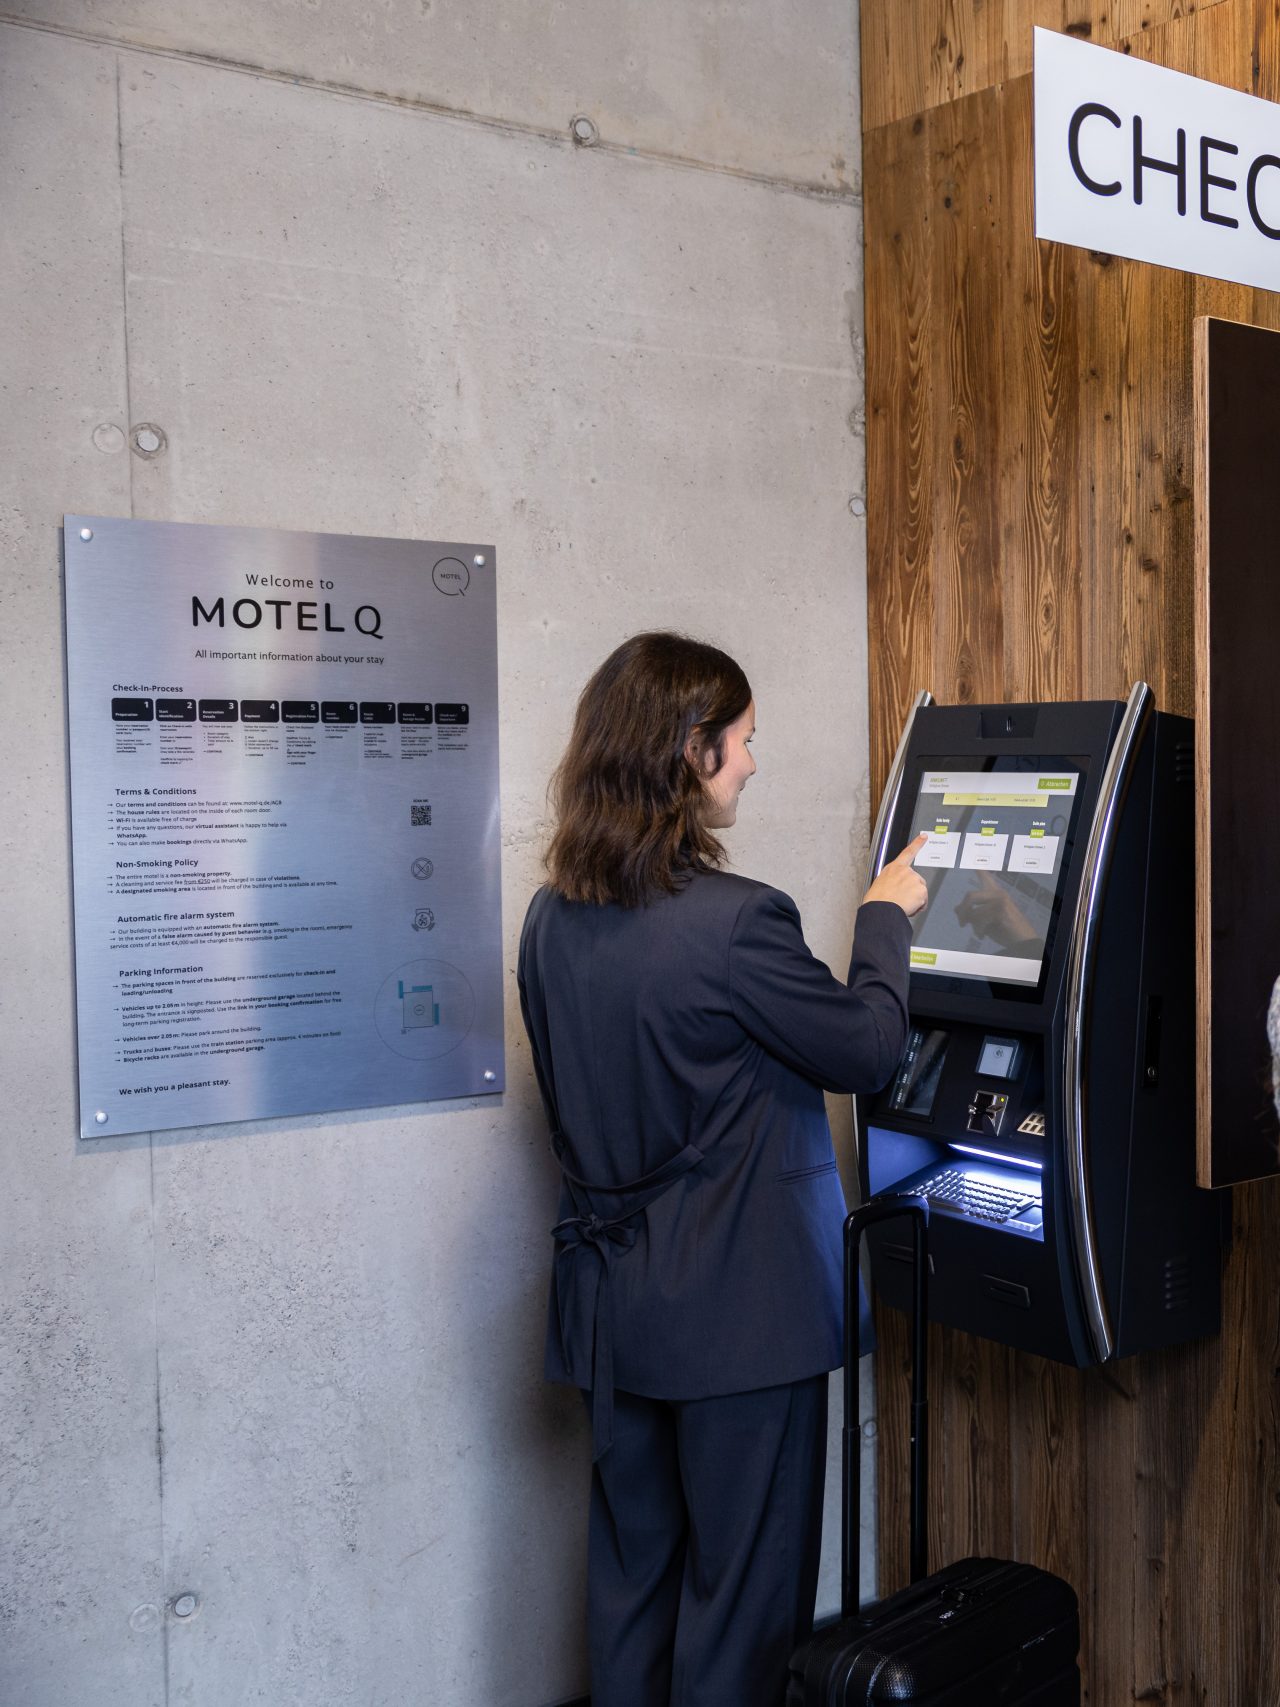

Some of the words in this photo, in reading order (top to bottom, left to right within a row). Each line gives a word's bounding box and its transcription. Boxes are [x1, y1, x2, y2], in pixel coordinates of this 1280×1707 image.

[246, 574, 314, 588] Welcome
[320, 579, 334, 589] to
[192, 596, 345, 632] MOTEL
[354, 605, 384, 639] Q
[195, 650, 207, 658] All
[209, 651, 257, 661] important
[259, 651, 313, 661] information
[315, 653, 342, 662] about
[344, 656, 364, 664] your
[366, 656, 385, 665] stay
[112, 684, 184, 693] Check-In-Process
[116, 860, 172, 870] Non-Smoking
[174, 859, 199, 868] Policy
[117, 914, 162, 923] Automatic
[206, 911, 235, 920] system
[119, 968, 152, 979] Parking
[153, 965, 203, 975] Information
[177, 1080, 211, 1091] pleasant
[212, 1079, 231, 1087] stay.
